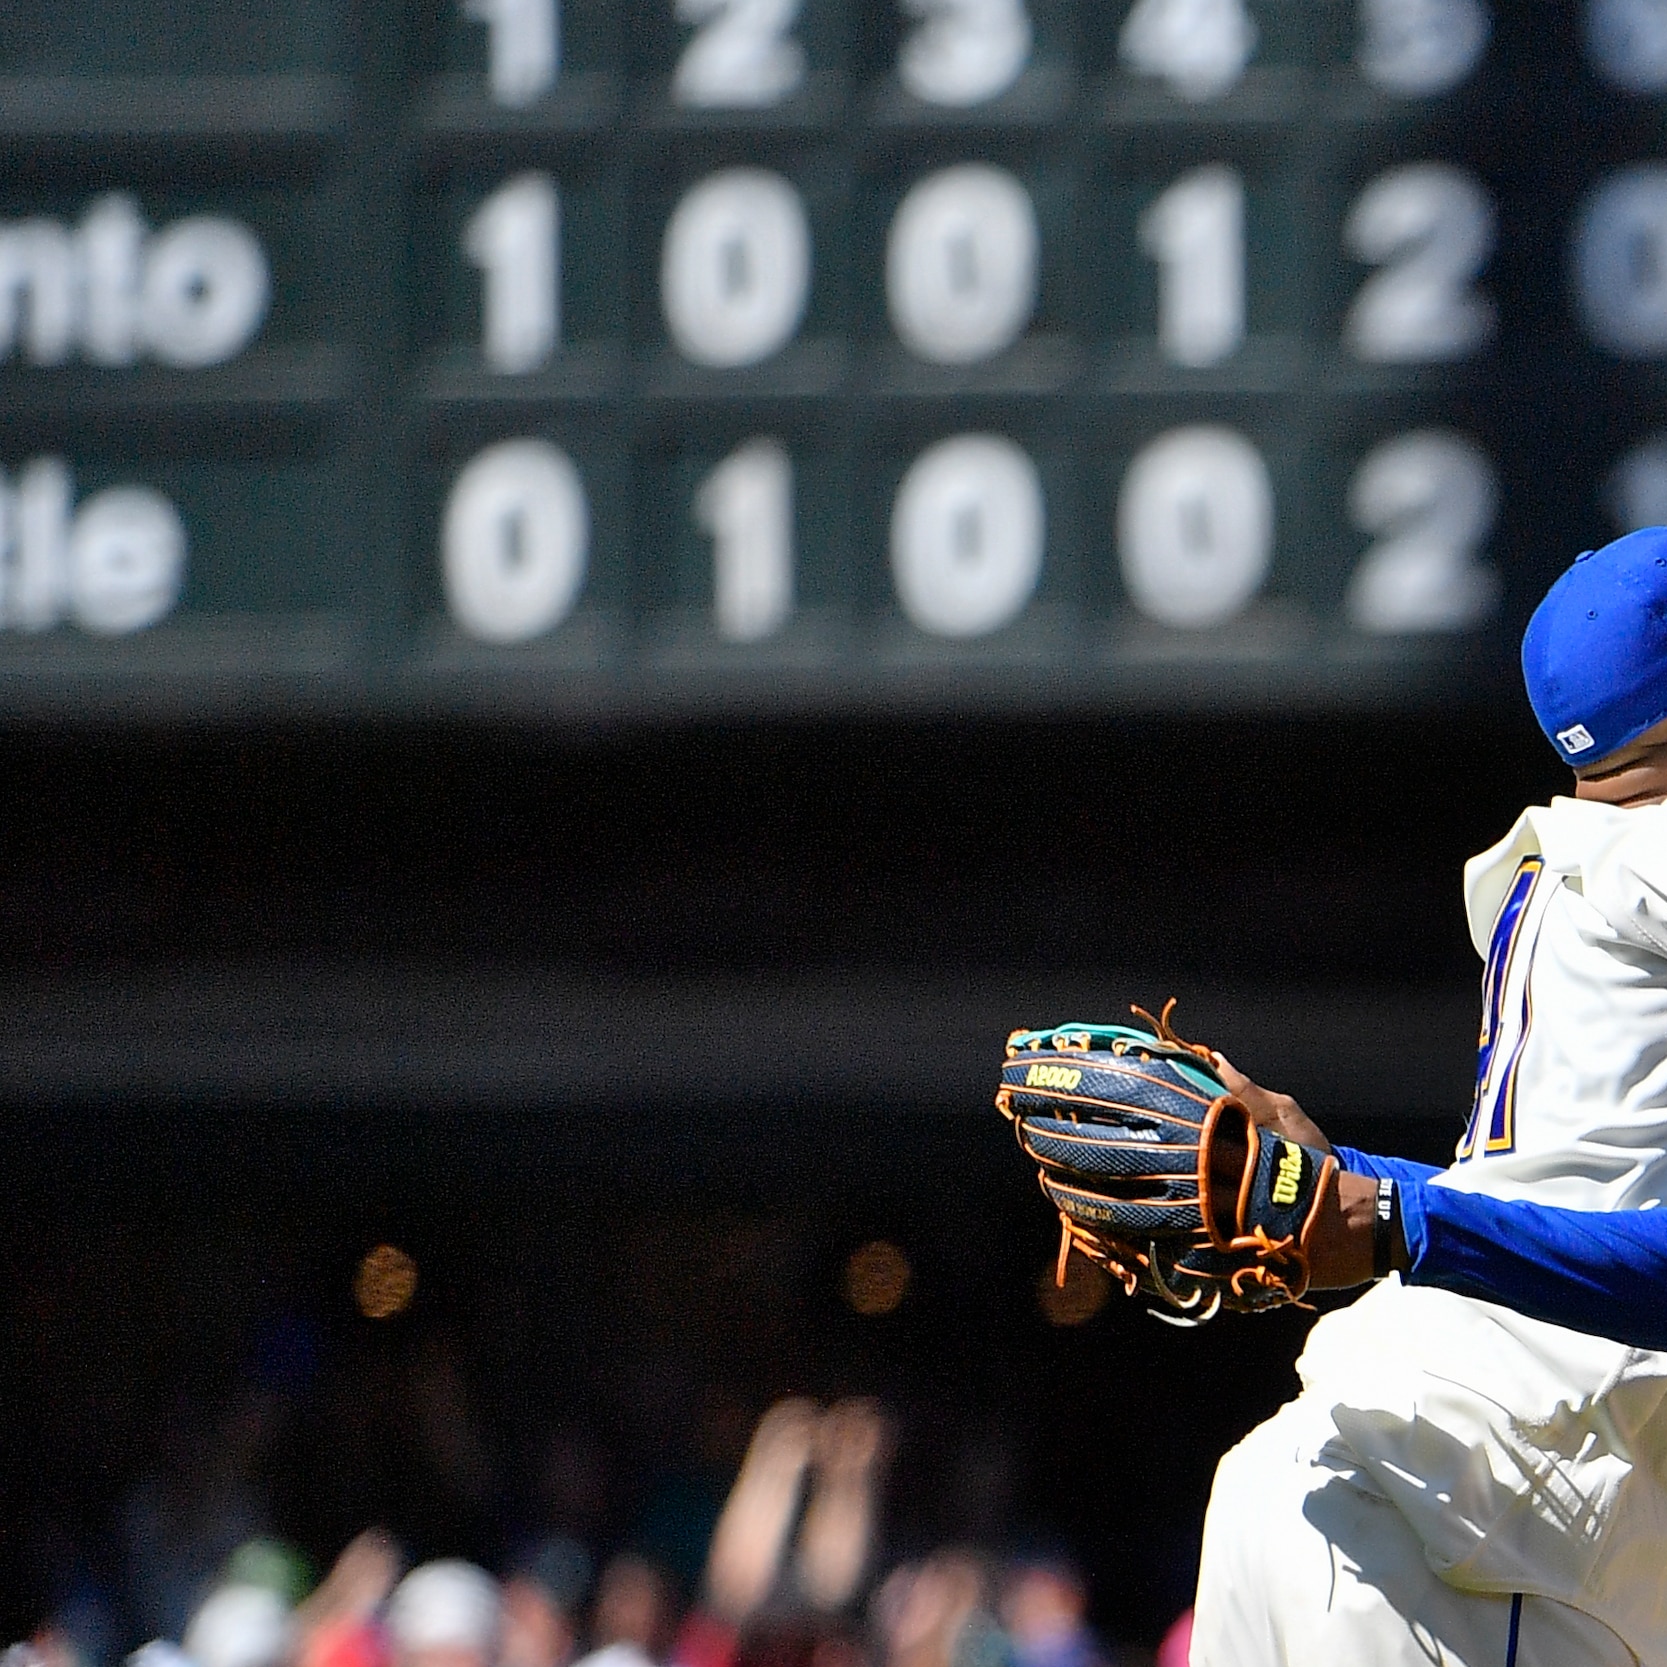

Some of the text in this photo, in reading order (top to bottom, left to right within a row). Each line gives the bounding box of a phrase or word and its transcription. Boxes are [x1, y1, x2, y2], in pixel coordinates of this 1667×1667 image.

[461, 168, 562, 375] 1
[660, 165, 812, 368] 0
[885, 162, 1040, 366] 0
[1137, 163, 1247, 368] 1
[1345, 160, 1496, 365] 2
[441, 437, 590, 643] 0
[695, 435, 795, 643] 1
[889, 432, 1045, 640] 0
[1114, 425, 1275, 632] 0
[1345, 428, 1503, 637] 2
[1026, 1064, 1082, 1090] A2000
